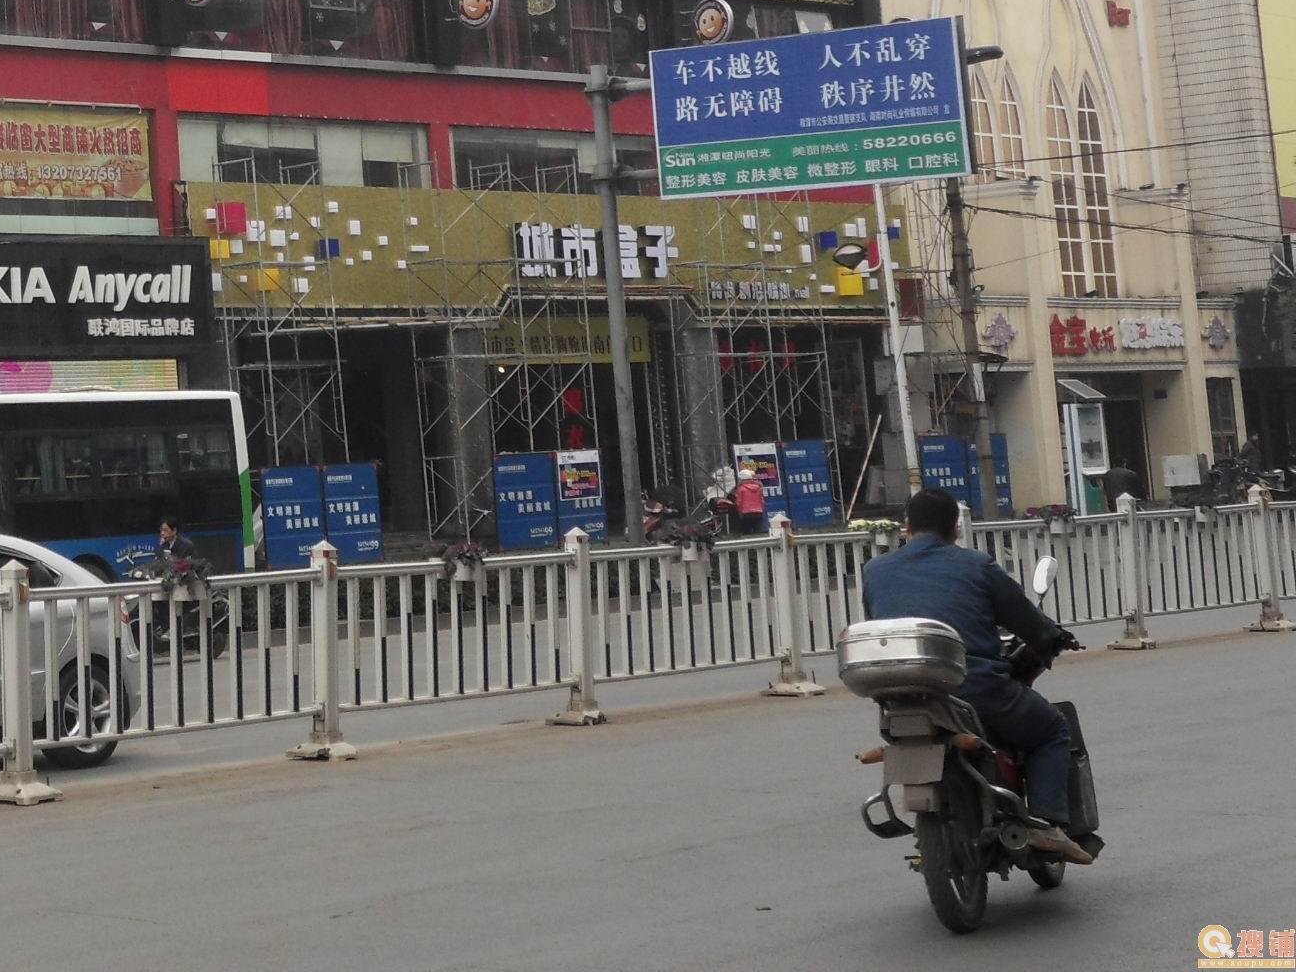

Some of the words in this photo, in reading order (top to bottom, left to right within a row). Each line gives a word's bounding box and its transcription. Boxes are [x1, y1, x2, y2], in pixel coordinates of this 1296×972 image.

[674, 50, 780, 85] 车不越线
[819, 34, 931, 70] 人不乱穿
[676, 87, 782, 122] 路无障碍
[820, 72, 935, 108] 秩序井然
[666, 153, 696, 167] Sun
[863, 131, 956, 149] 58220666
[38, 164, 121, 181] 13207327561
[666, 172, 727, 189] 整形美容
[736, 166, 799, 183] 皮肤美容
[807, 160, 856, 178] 微整形
[865, 157, 898, 172] 眼科
[908, 153, 959, 169] 口腔科
[520, 222, 679, 278] 城市盒子
[68, 264, 192, 311] Anycall
